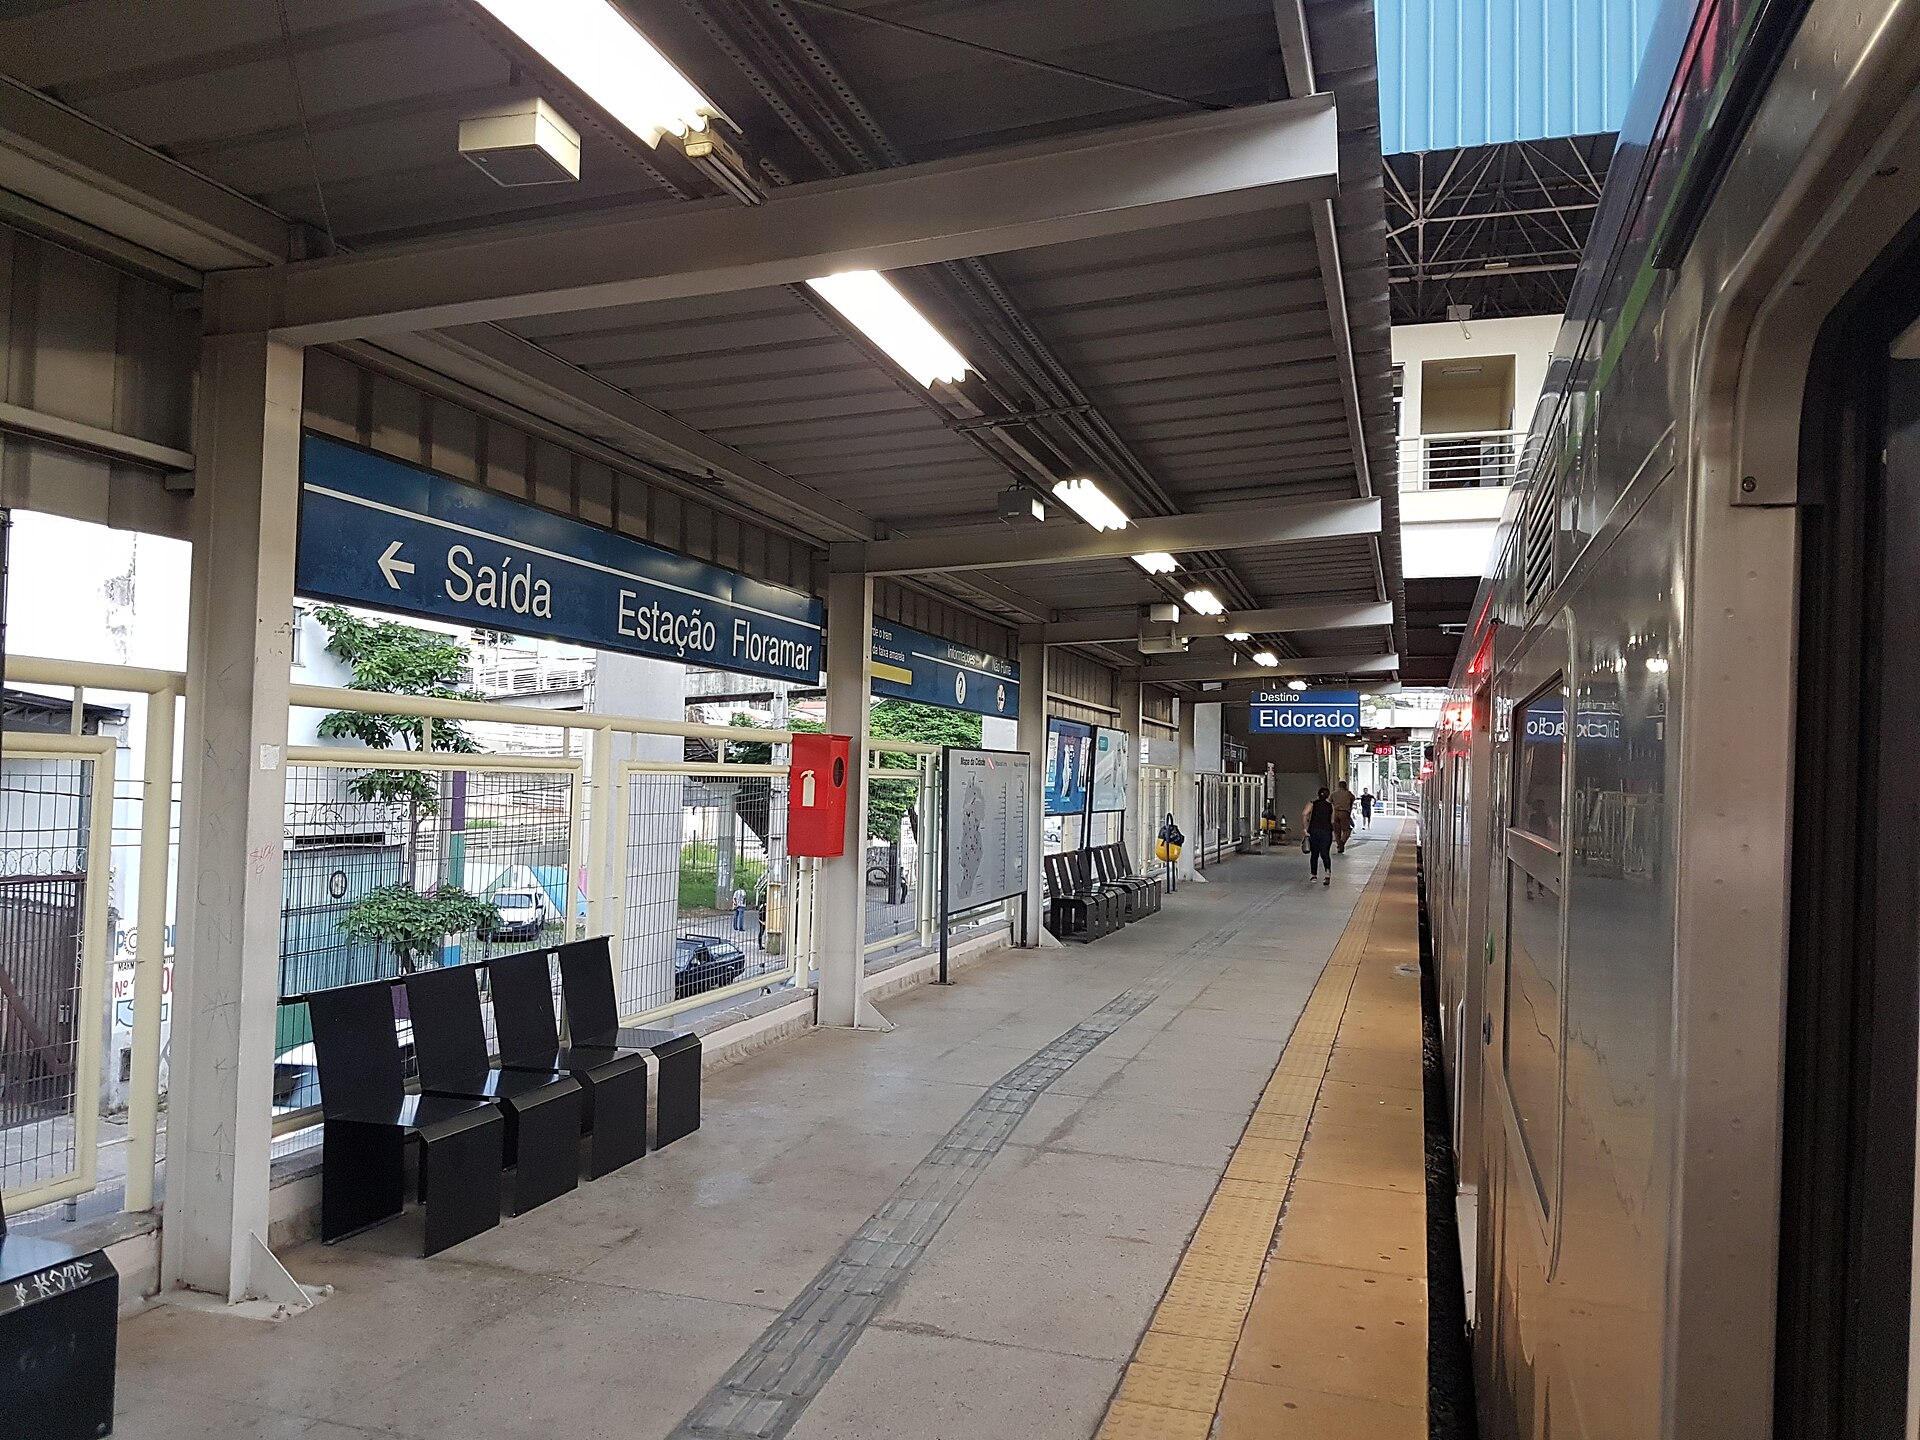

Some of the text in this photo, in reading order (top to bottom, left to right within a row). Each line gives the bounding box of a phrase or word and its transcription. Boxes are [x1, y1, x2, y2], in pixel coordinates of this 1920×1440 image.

[445, 545, 813, 671] Saída Estação Floramar
[947, 644, 975, 666] Informações
[1260, 692, 1300, 702] Destino
[1259, 709, 1355, 728] Eldorado
